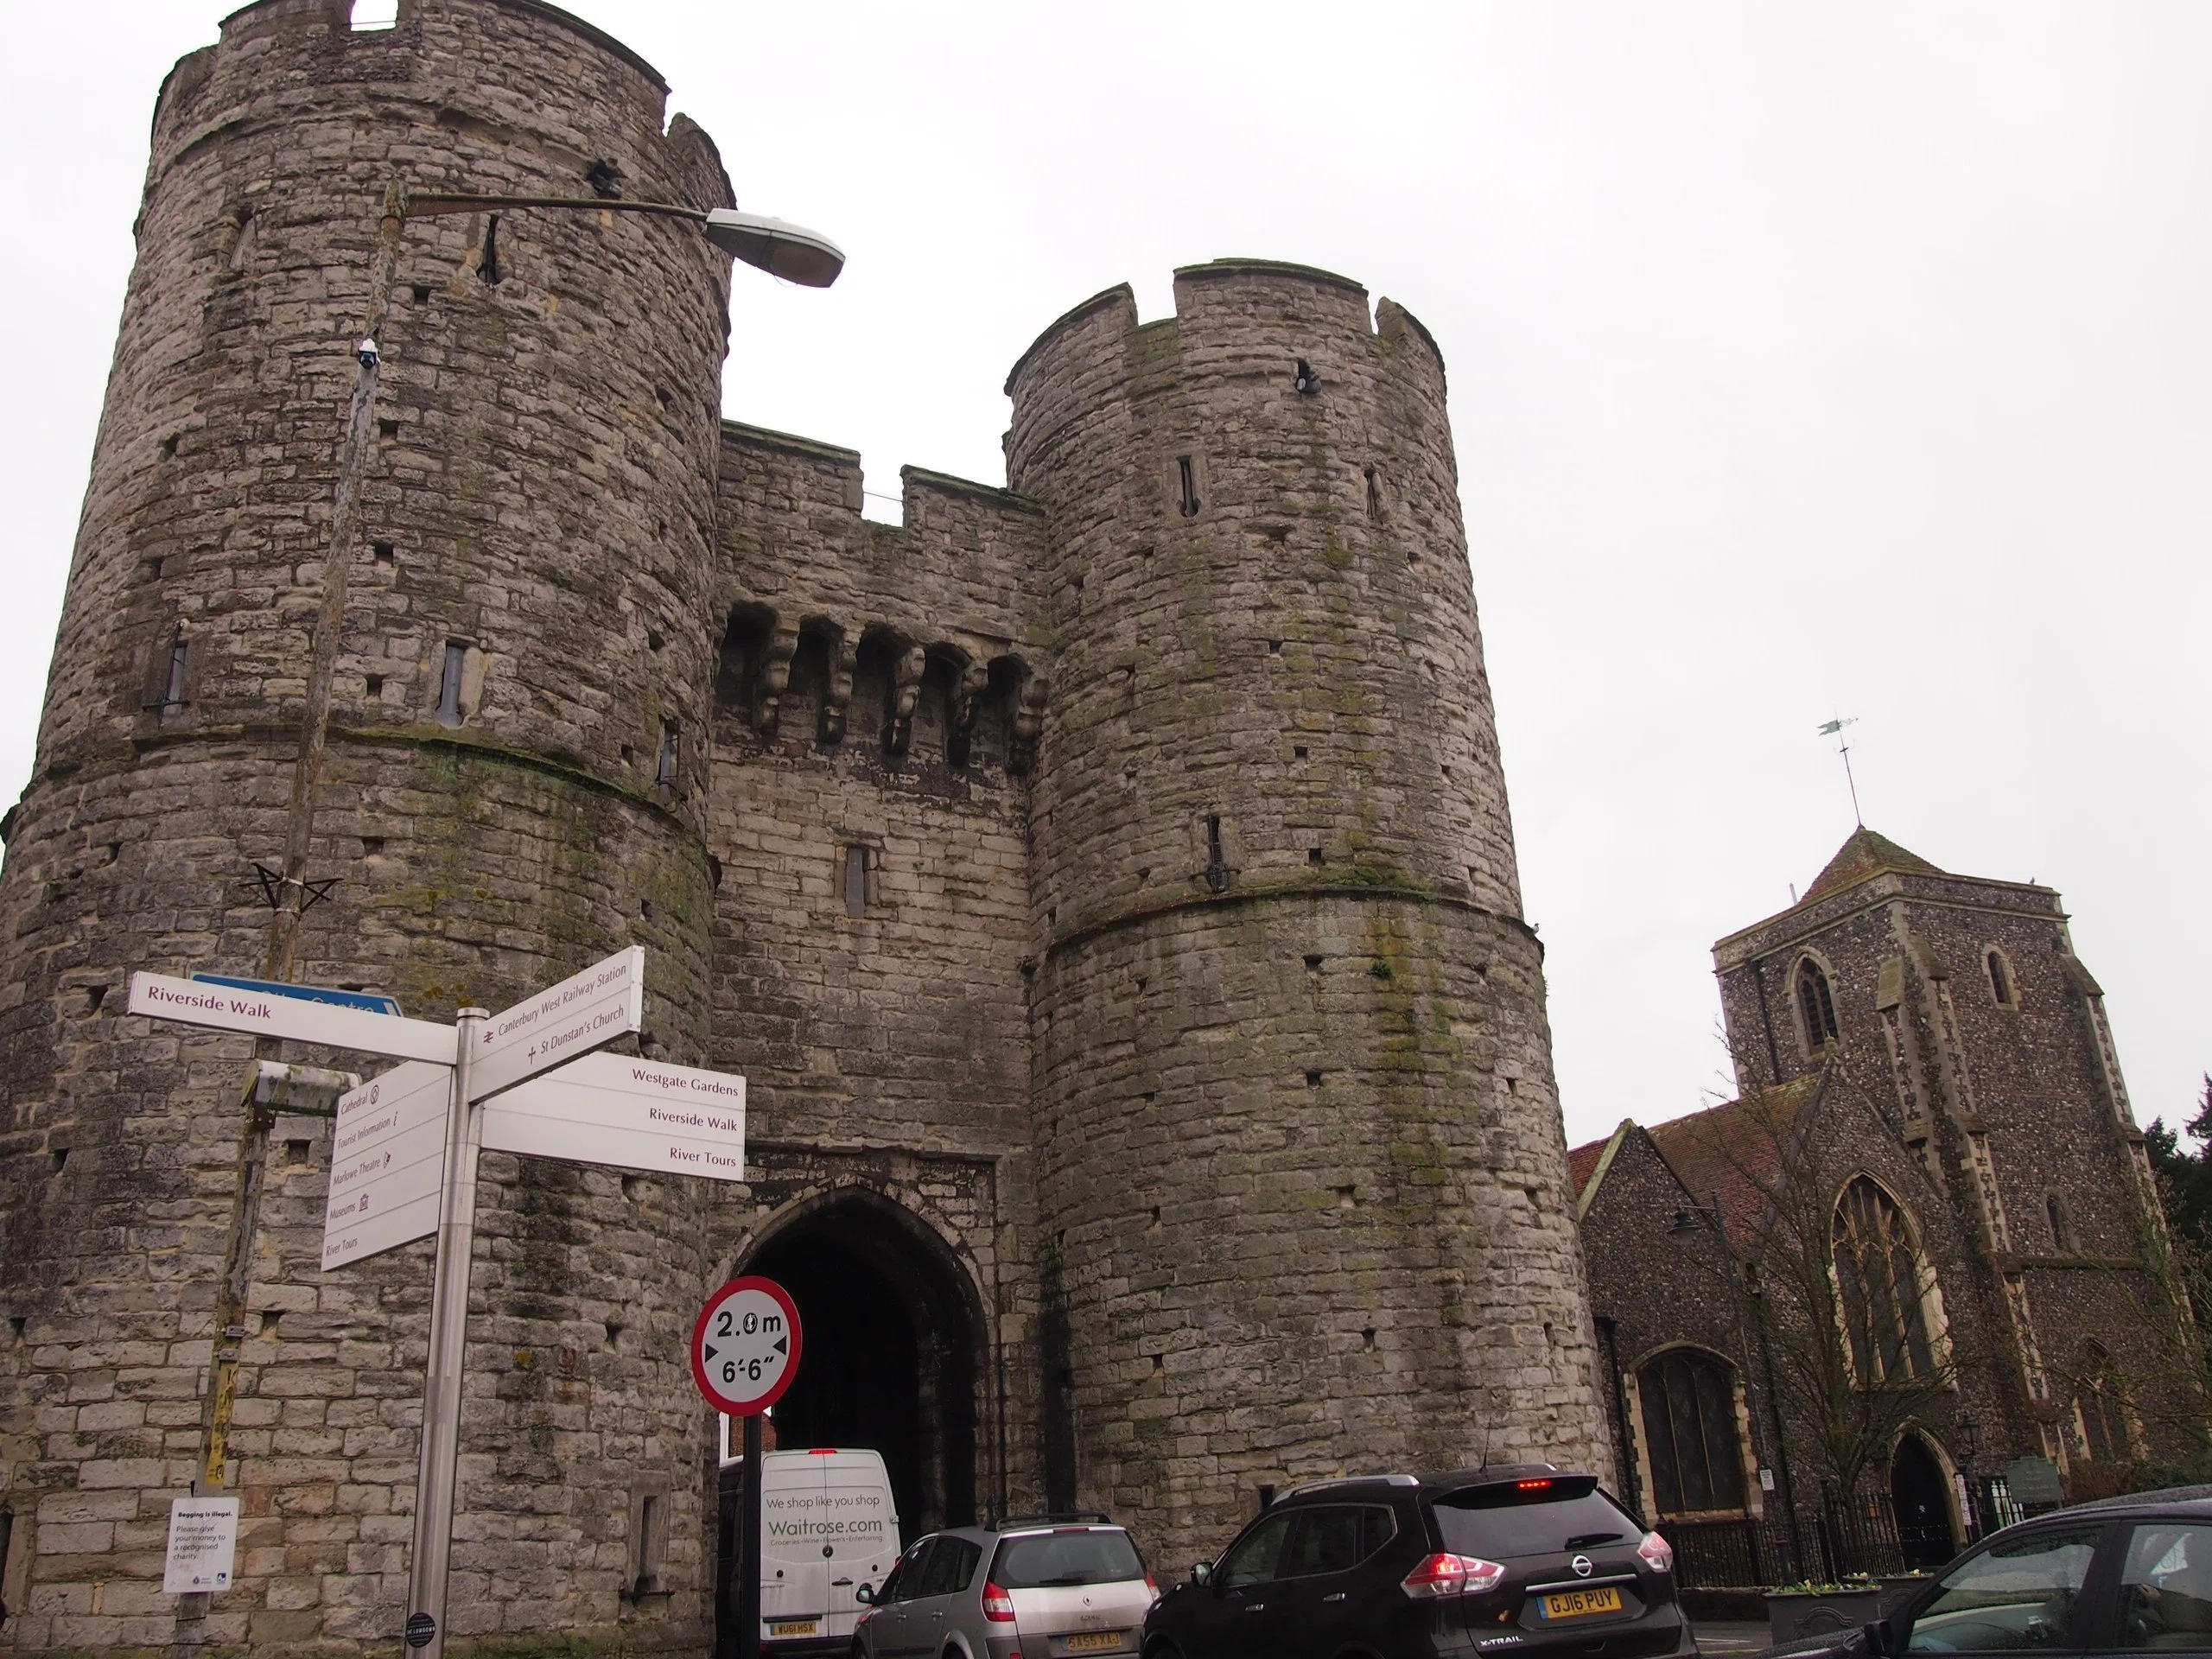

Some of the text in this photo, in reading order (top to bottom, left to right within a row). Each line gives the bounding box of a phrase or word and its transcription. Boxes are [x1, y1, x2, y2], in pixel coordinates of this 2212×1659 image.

[148, 986, 271, 1019] Riverside Walk
[499, 964, 626, 1036] Canterbury West Railway Station
[540, 1004, 624, 1054] St Dunstan's Church
[632, 1068, 739, 1096] Westgate Gardens
[341, 1090, 368, 1115] Cathedral
[649, 1107, 738, 1132] Riverside Walk
[338, 1133, 356, 1149] Tourist
[357, 1118, 391, 1141] Information
[670, 1147, 737, 1167] River Tours
[334, 1158, 381, 1185] Marlowe Theatre
[329, 1203, 356, 1221] Museums
[326, 1237, 358, 1257] River Tours
[766, 1494, 880, 1510] We shop like you shop
[200, 1525, 215, 1534] give
[768, 1518, 882, 1536] Waitrose.com
[180, 1542, 219, 1552] recognised
[1550, 1591, 1612, 1613] GJ16 PUY
[1480, 1635, 1523, 1647] X-TRAIL
